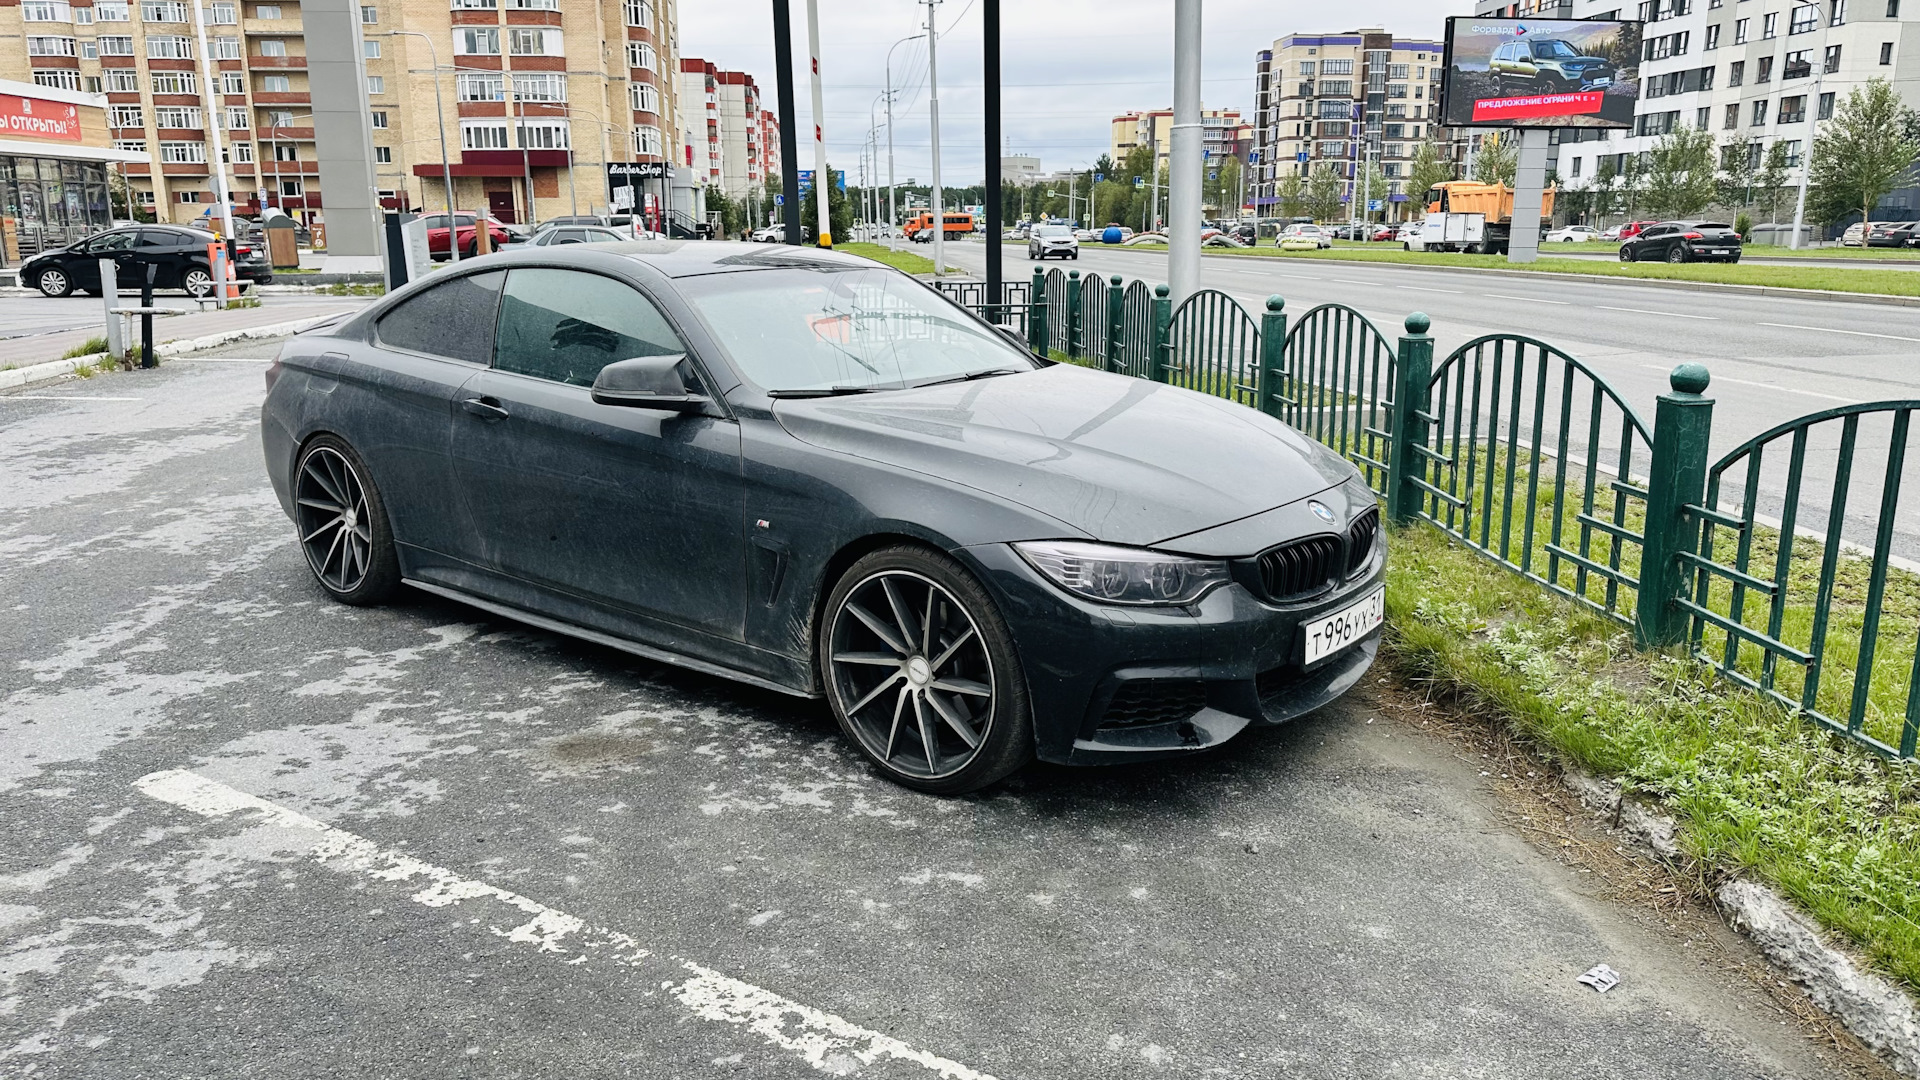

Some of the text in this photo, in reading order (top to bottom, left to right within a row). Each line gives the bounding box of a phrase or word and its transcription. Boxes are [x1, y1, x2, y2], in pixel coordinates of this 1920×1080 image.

[1471, 24, 1552, 36] Форвард Авто
[1477, 96, 1543, 109] ПРЕДЛОЖЕНИЕ
[11, 115, 68, 134] ОТКРЫТЫ!
[609, 164, 662, 176] BarberShop
